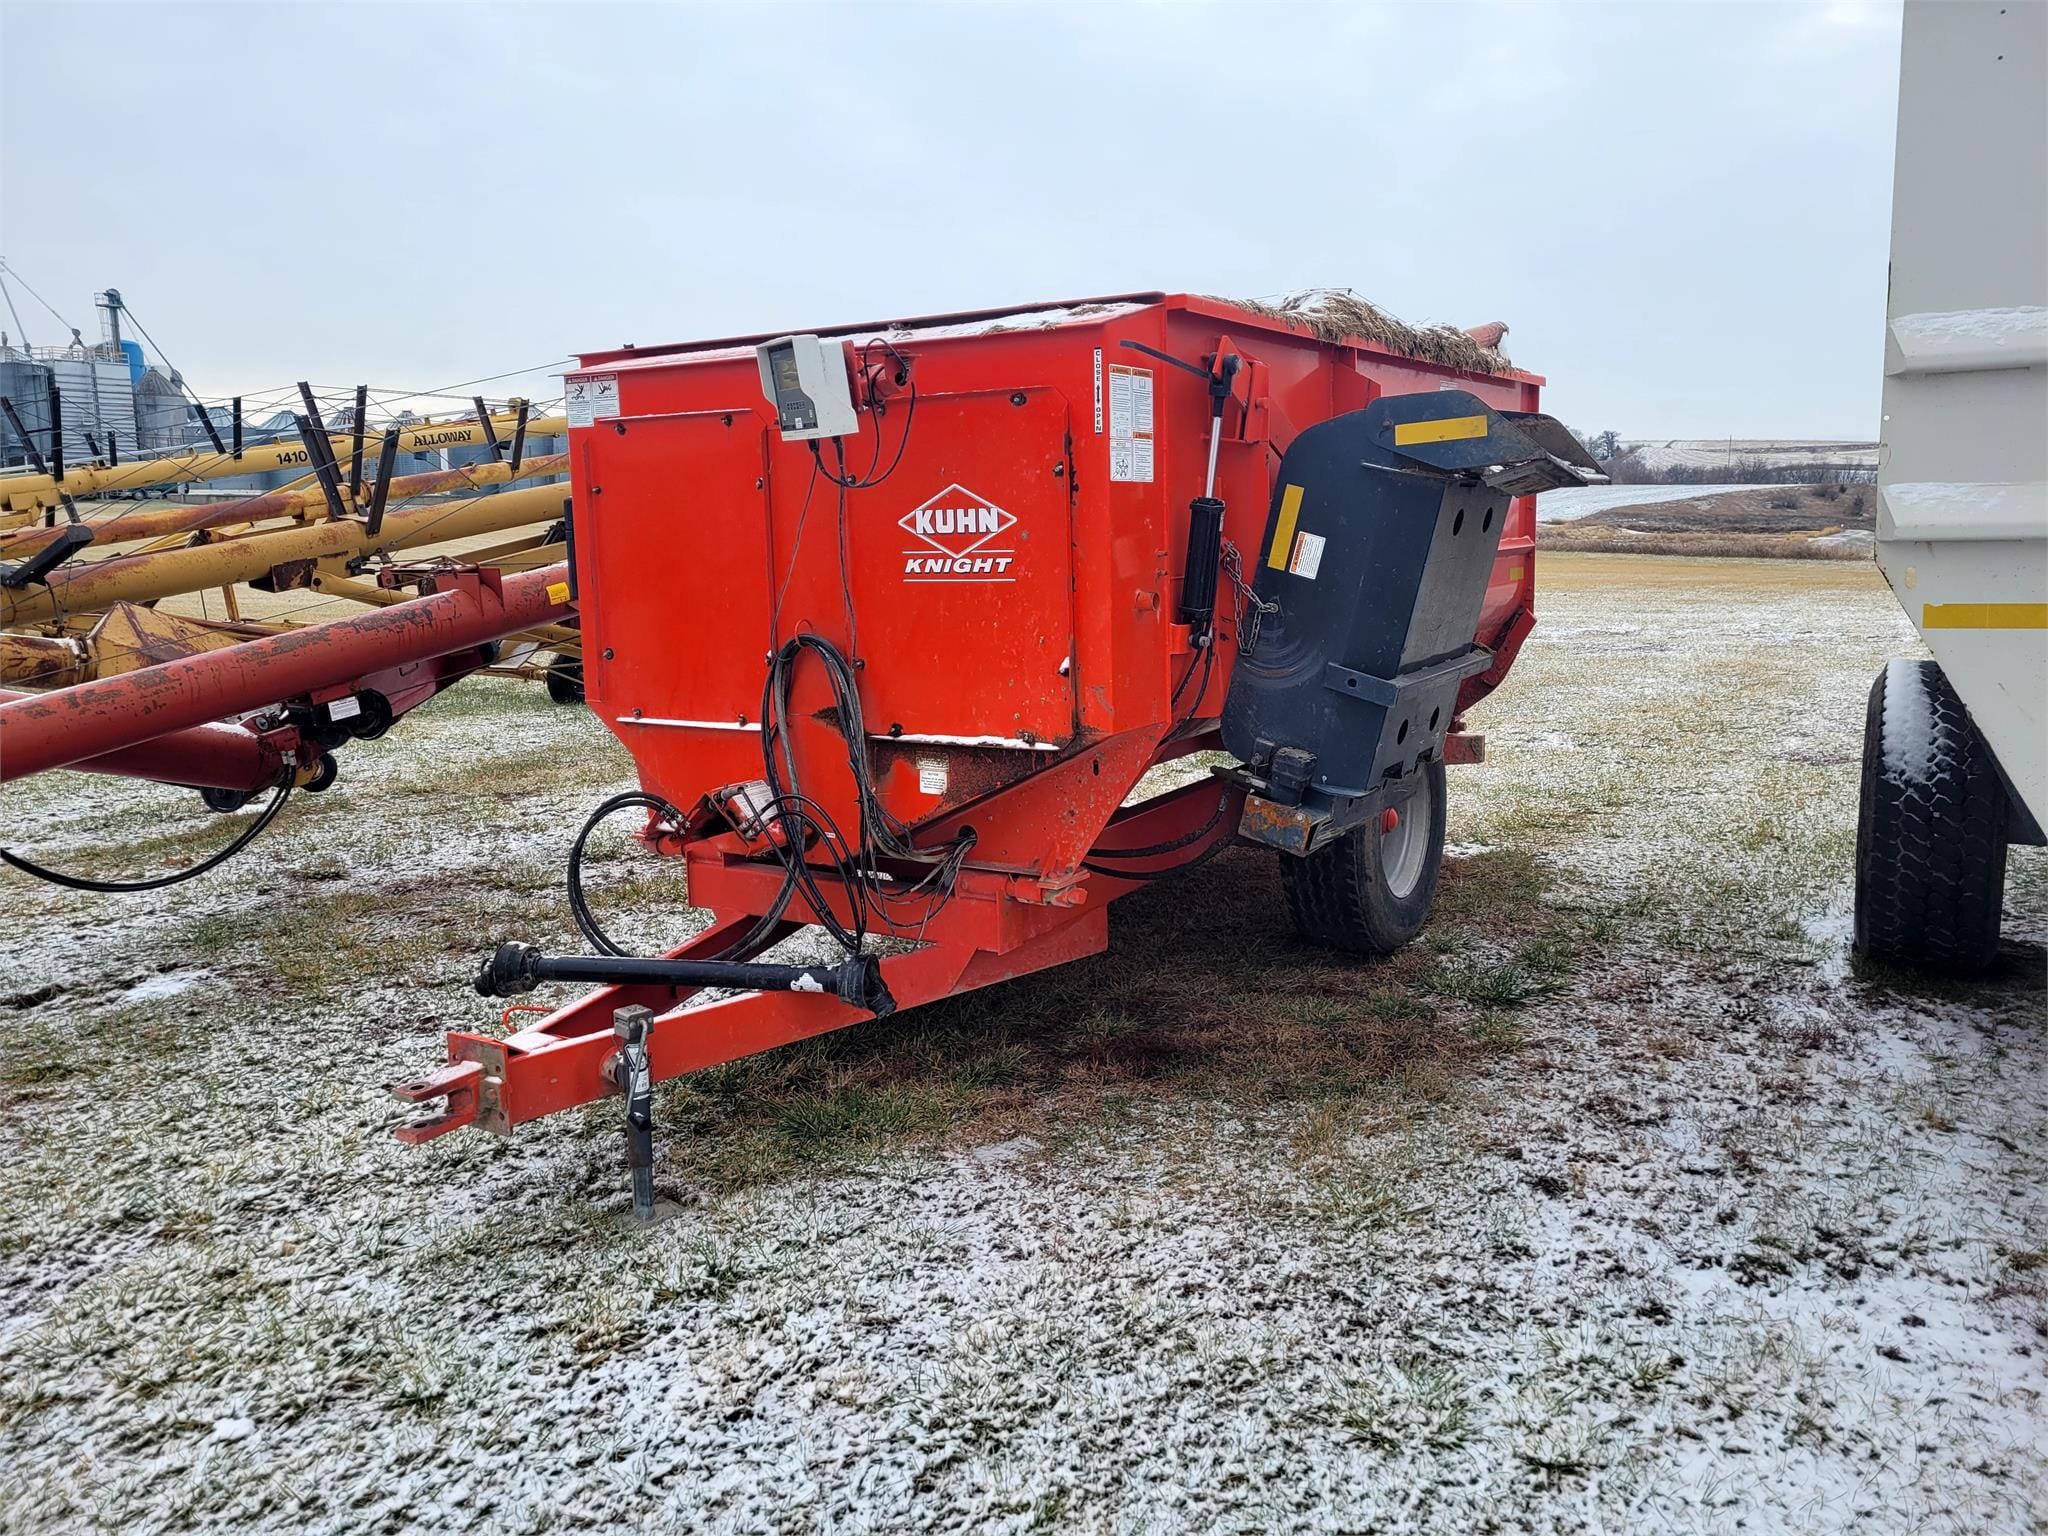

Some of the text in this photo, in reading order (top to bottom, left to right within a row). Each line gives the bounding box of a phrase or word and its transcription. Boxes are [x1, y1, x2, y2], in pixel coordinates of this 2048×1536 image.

[413, 430, 472, 447] ALLOWAY
[276, 450, 308, 465] 1410
[915, 507, 999, 535] KUHN
[904, 558, 1013, 574] KNIGHT
